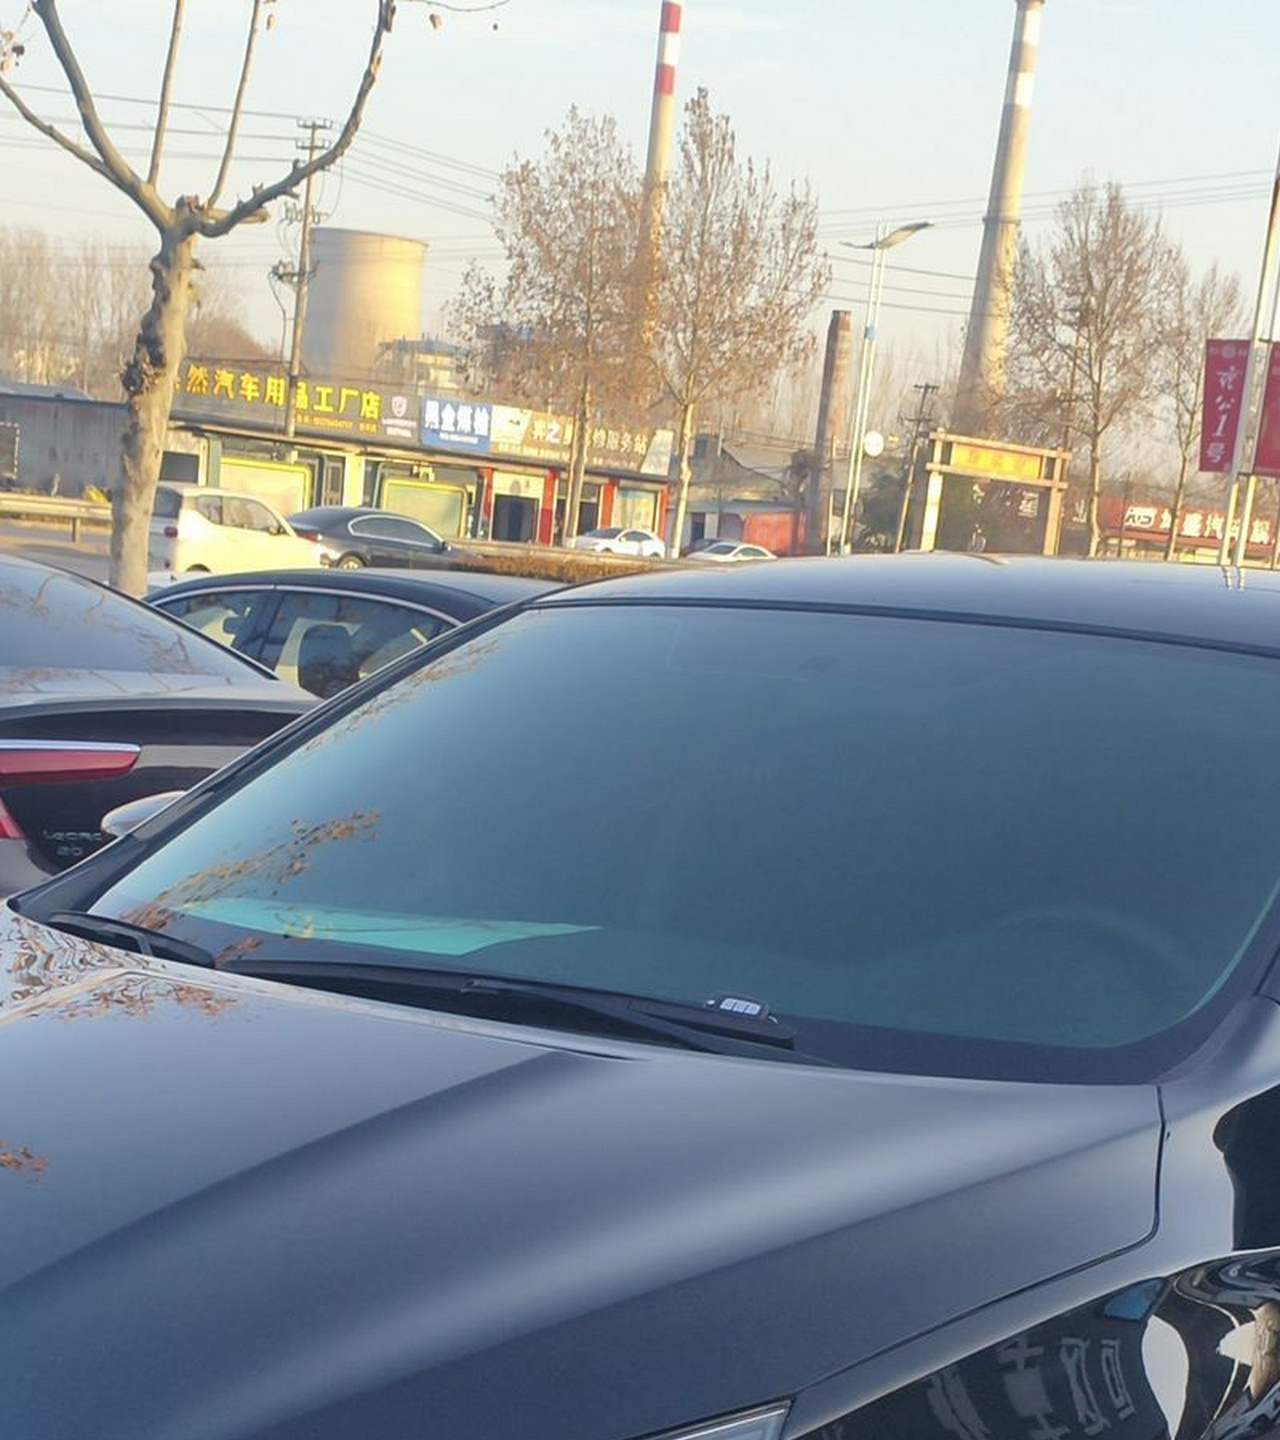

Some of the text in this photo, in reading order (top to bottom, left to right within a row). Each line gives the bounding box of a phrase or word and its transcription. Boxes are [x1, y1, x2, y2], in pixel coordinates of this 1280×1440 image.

[173, 364, 381, 421] 然汽车用品工厂店
